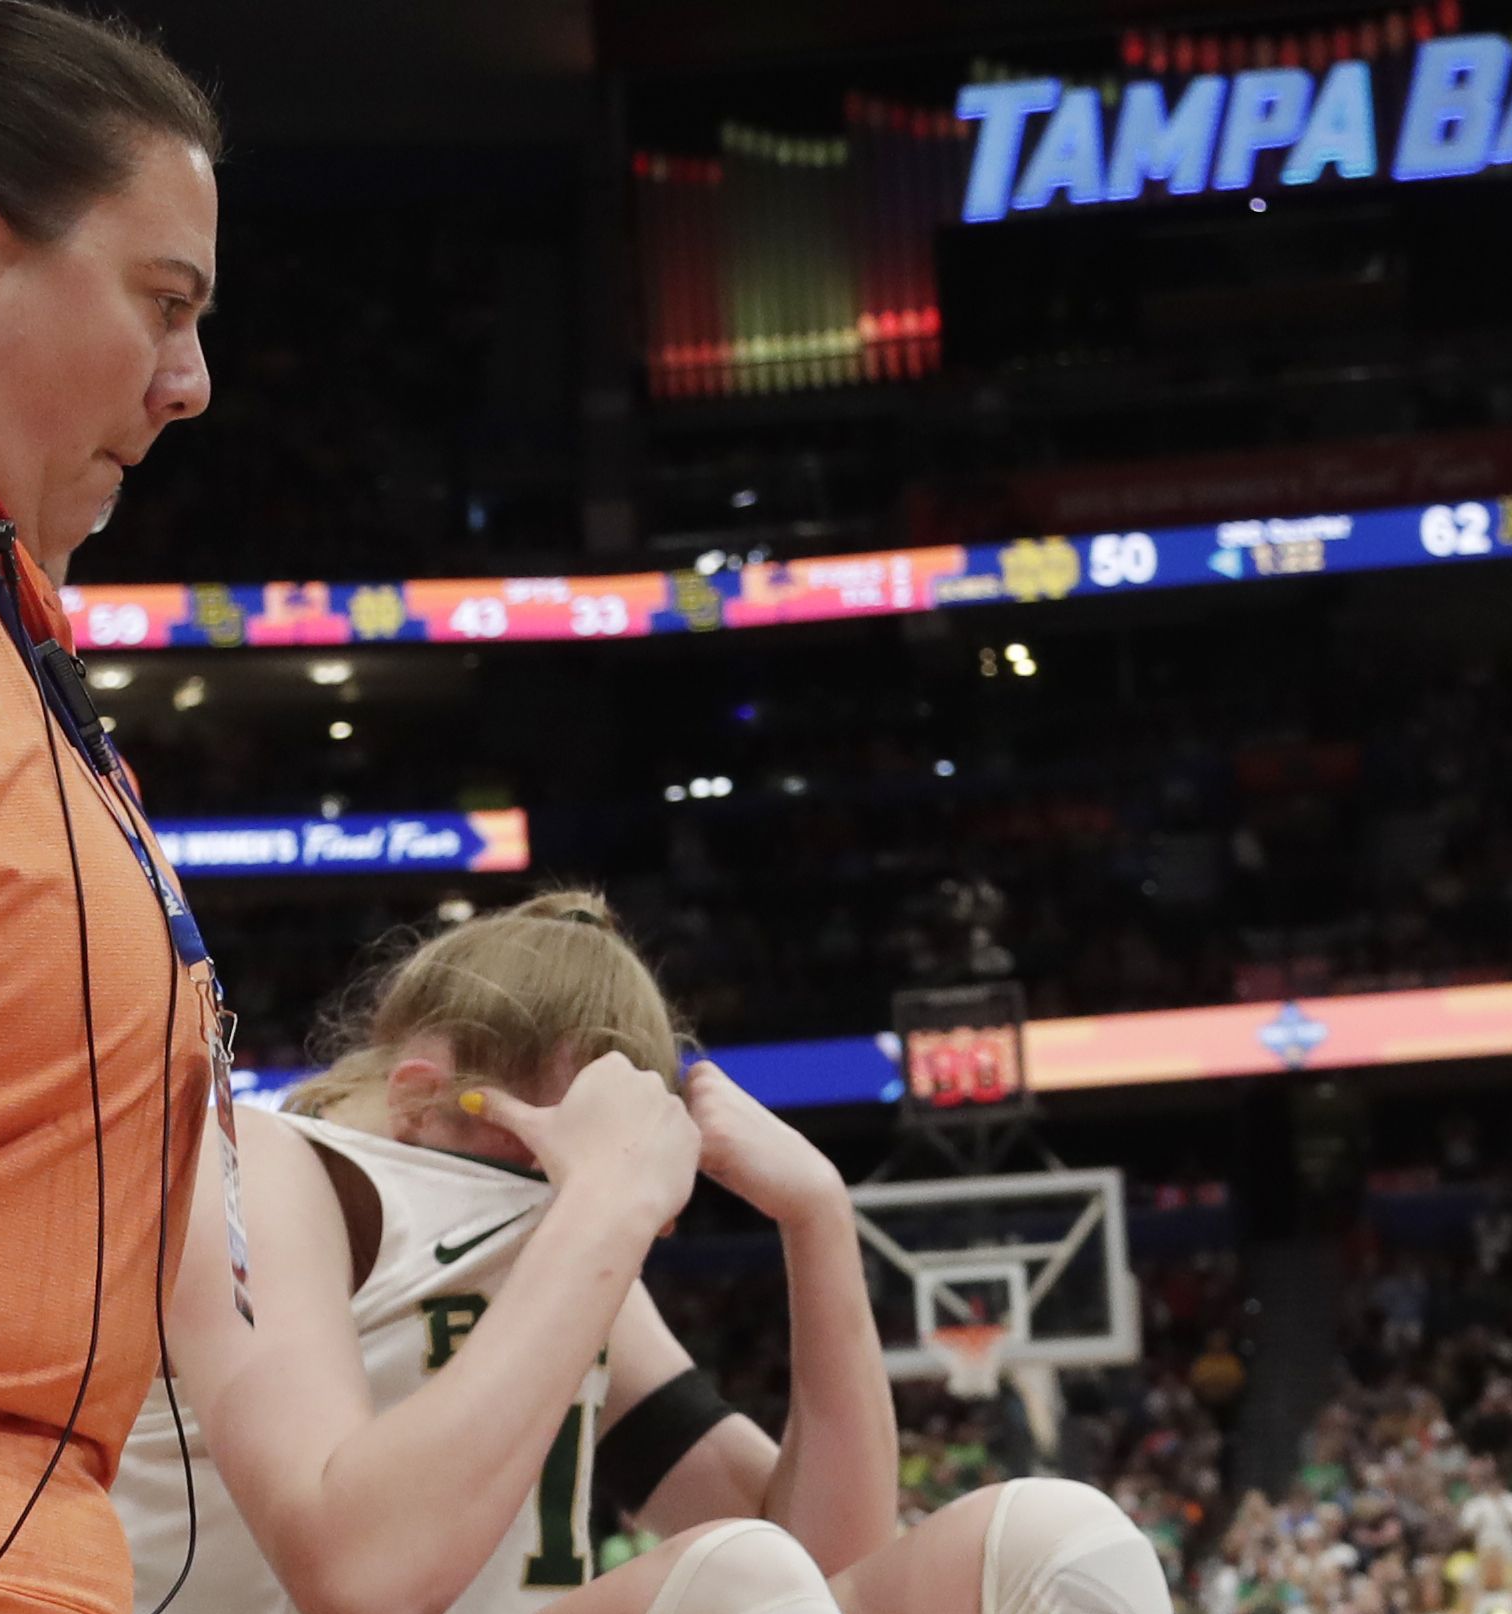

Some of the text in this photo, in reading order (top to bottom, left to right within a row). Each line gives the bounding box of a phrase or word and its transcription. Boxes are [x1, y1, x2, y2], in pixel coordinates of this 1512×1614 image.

[957, 60, 1376, 222] TAMPA
[1090, 532, 1158, 587] 50
[1419, 502, 1492, 557] 62
[570, 594, 628, 636] 33
[302, 820, 386, 866] Final
